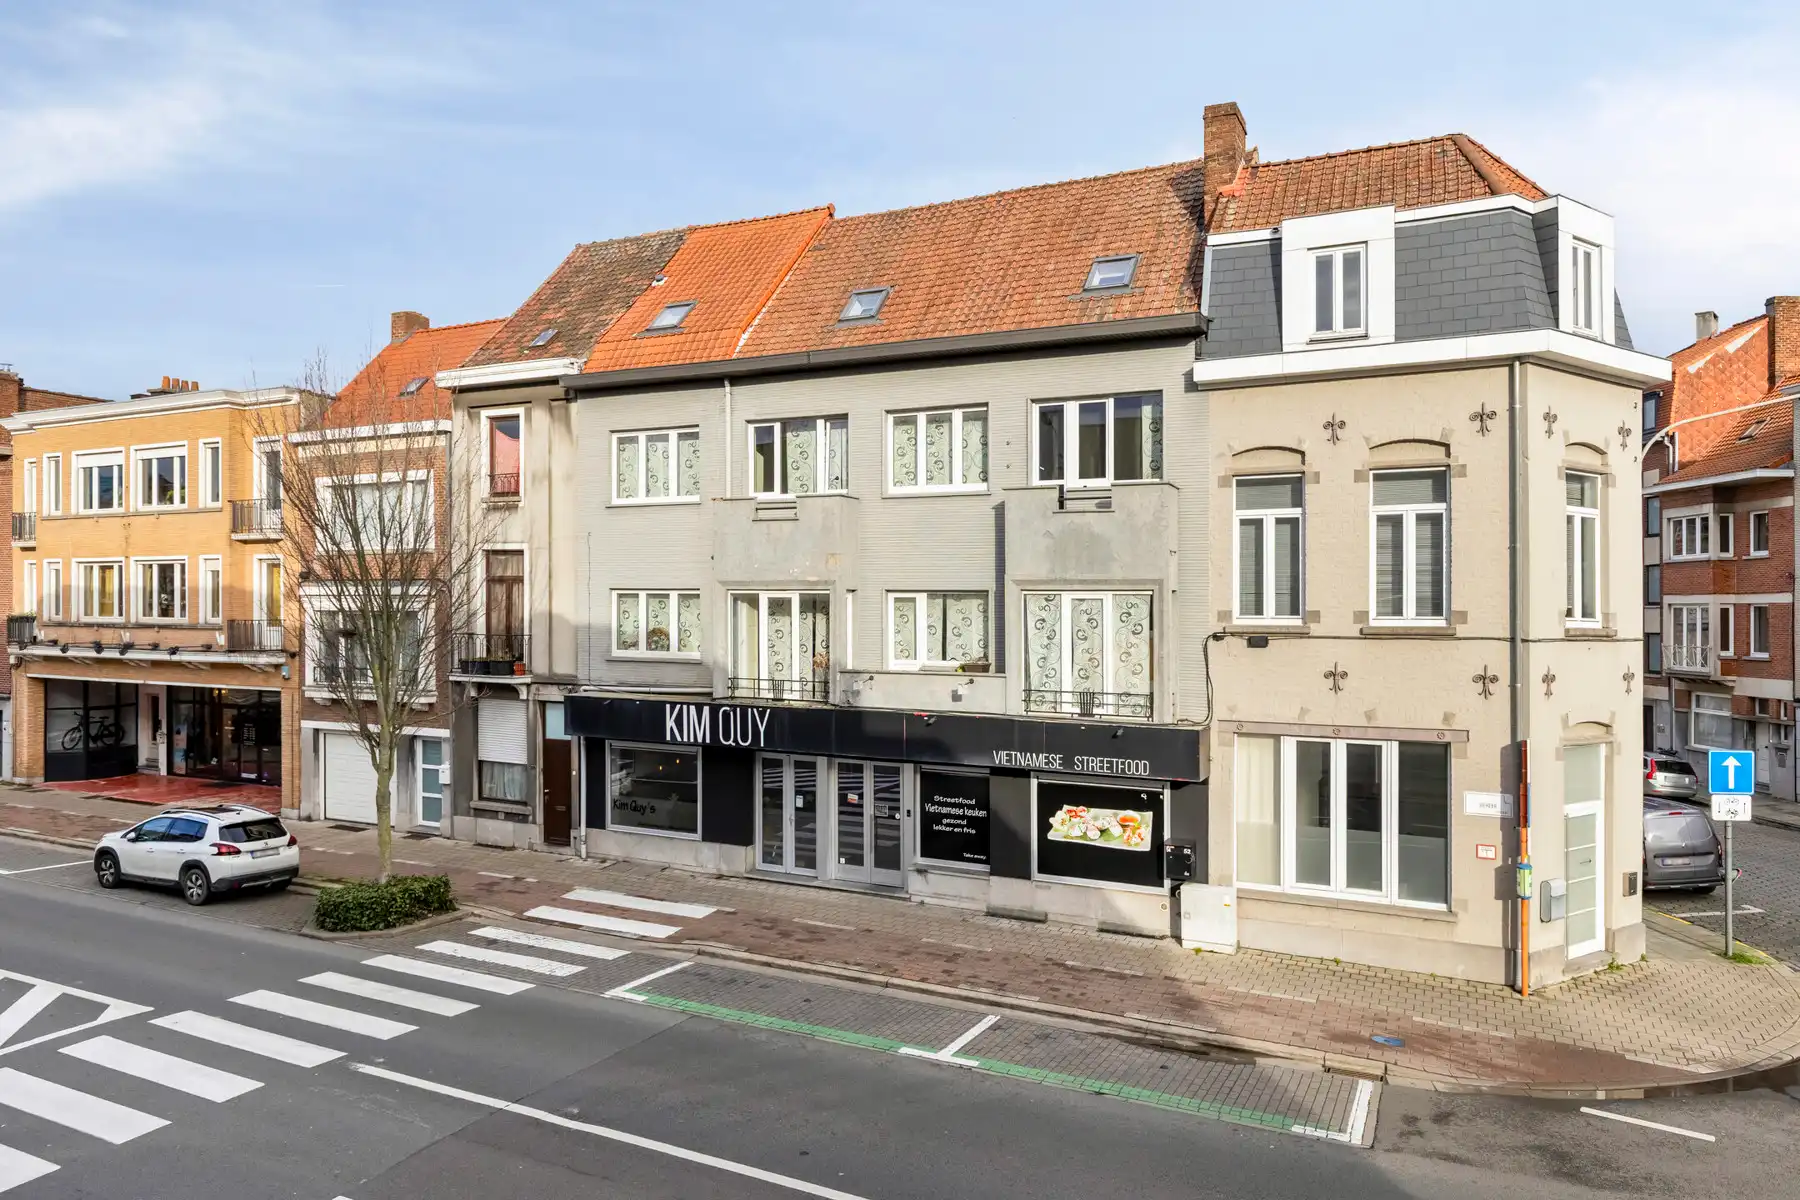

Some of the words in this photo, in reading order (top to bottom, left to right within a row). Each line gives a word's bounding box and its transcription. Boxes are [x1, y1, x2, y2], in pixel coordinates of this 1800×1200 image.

[665, 703, 711, 744] KIM
[719, 706, 771, 748] QUY
[993, 750, 1064, 770] VIETNAMESE
[1074, 755, 1150, 776] STREETFOOD
[613, 798, 629, 811] Kim
[630, 800, 657, 816] Quy's
[933, 795, 976, 805] Streetfood
[925, 803, 964, 816] Vietnamese
[964, 806, 988, 818] keuken
[933, 823, 954, 832] lekker
[963, 826, 977, 834] fris
